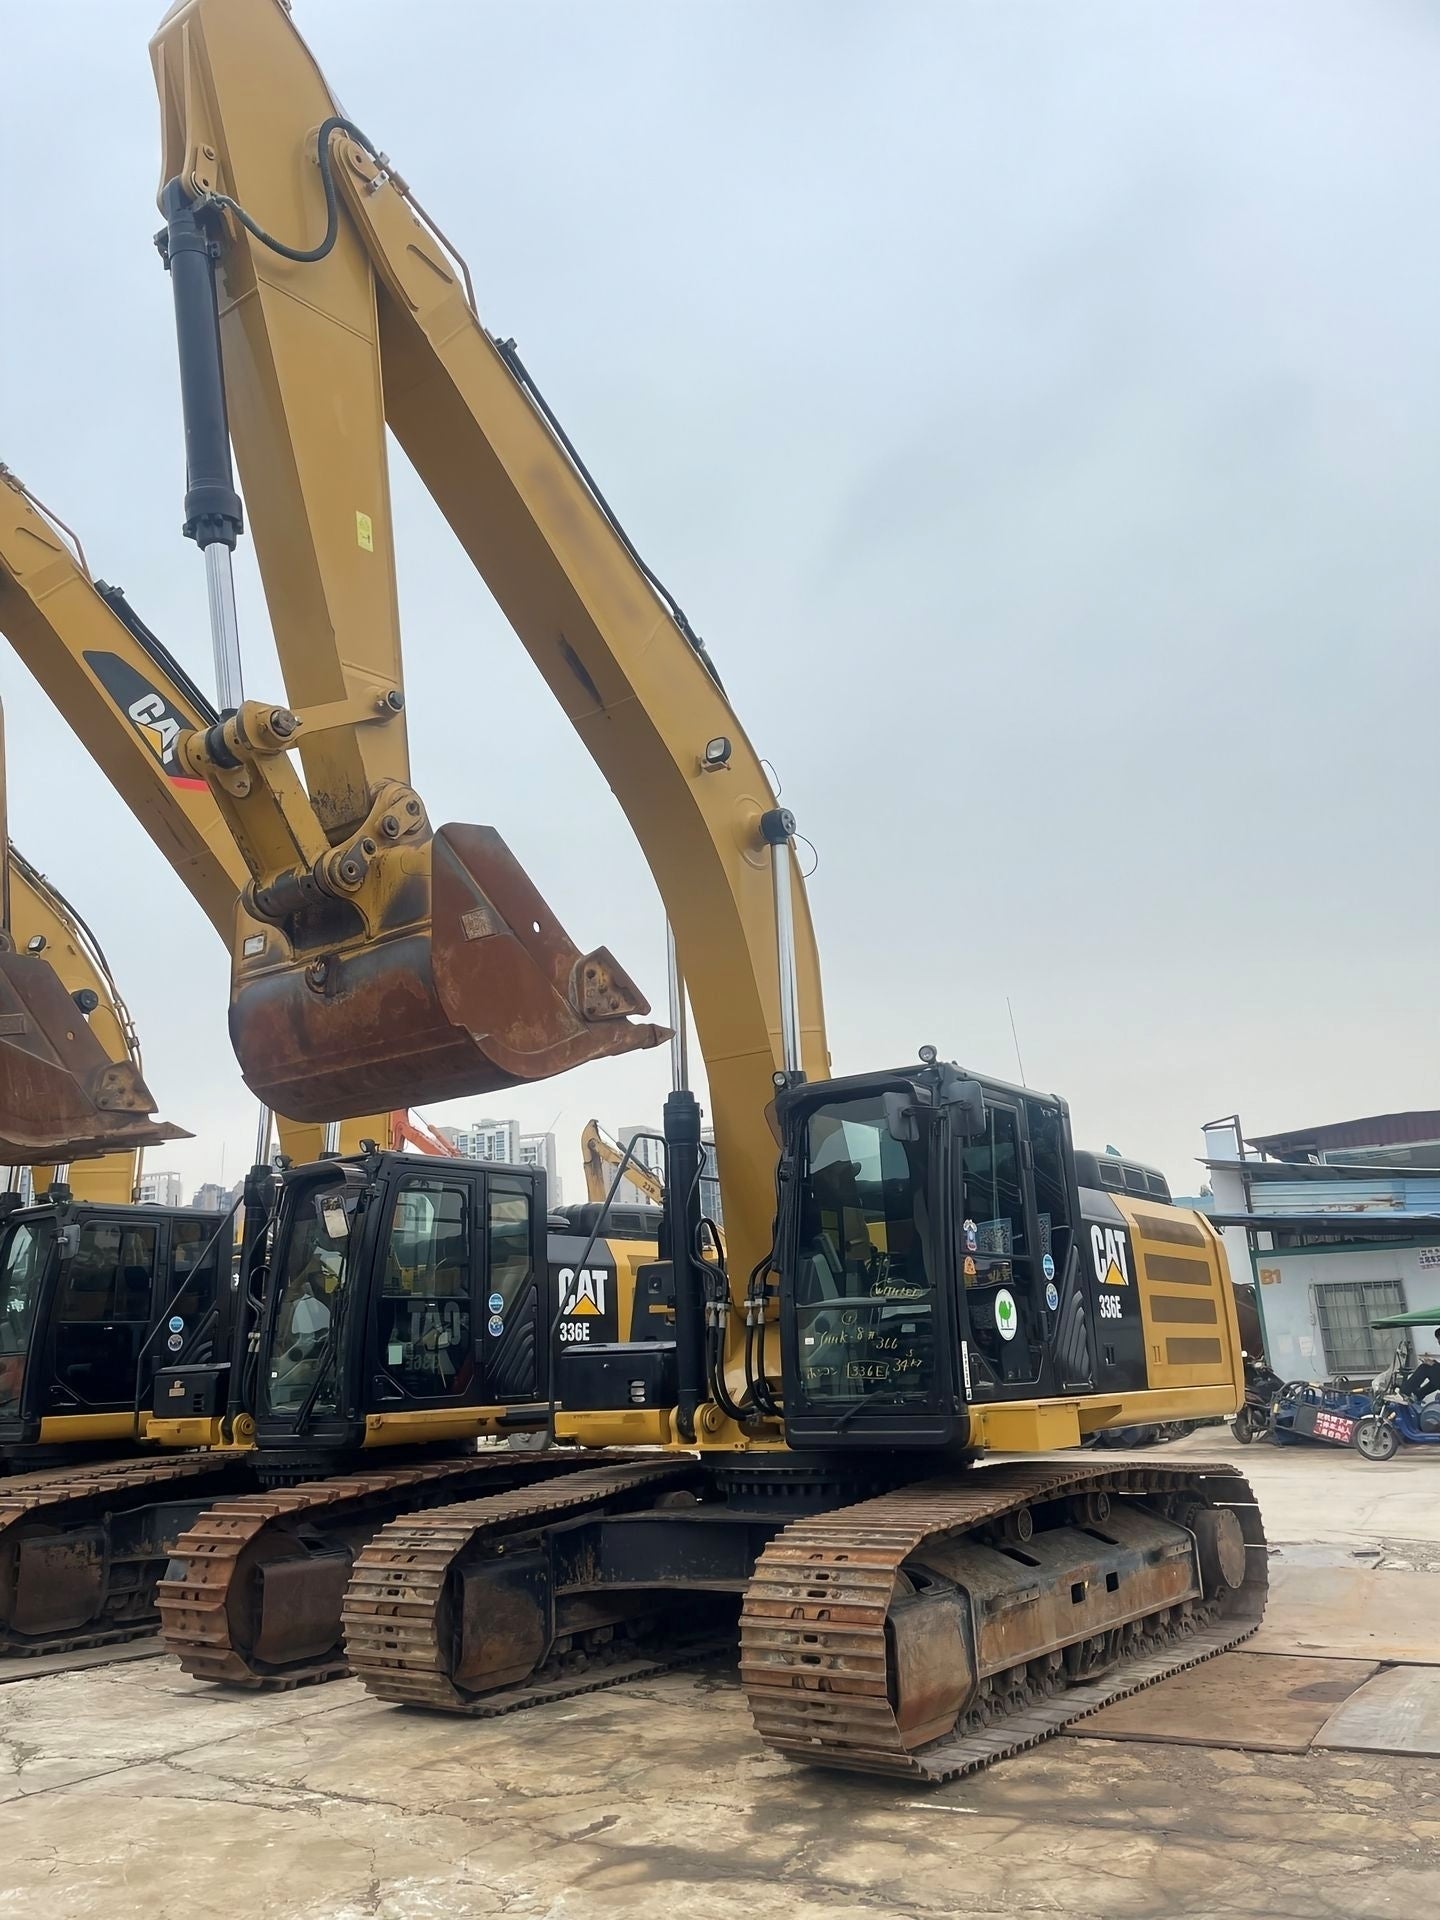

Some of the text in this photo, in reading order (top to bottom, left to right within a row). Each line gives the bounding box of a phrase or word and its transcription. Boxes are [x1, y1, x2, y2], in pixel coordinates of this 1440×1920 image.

[1091, 1225, 1129, 1286] CAT
[1260, 1269, 1281, 1284] B1
[559, 1268, 608, 1315] CAT
[1099, 1294, 1122, 1318] 336E
[560, 1322, 590, 1341] 336E
[851, 1365, 884, 1377] 336E
